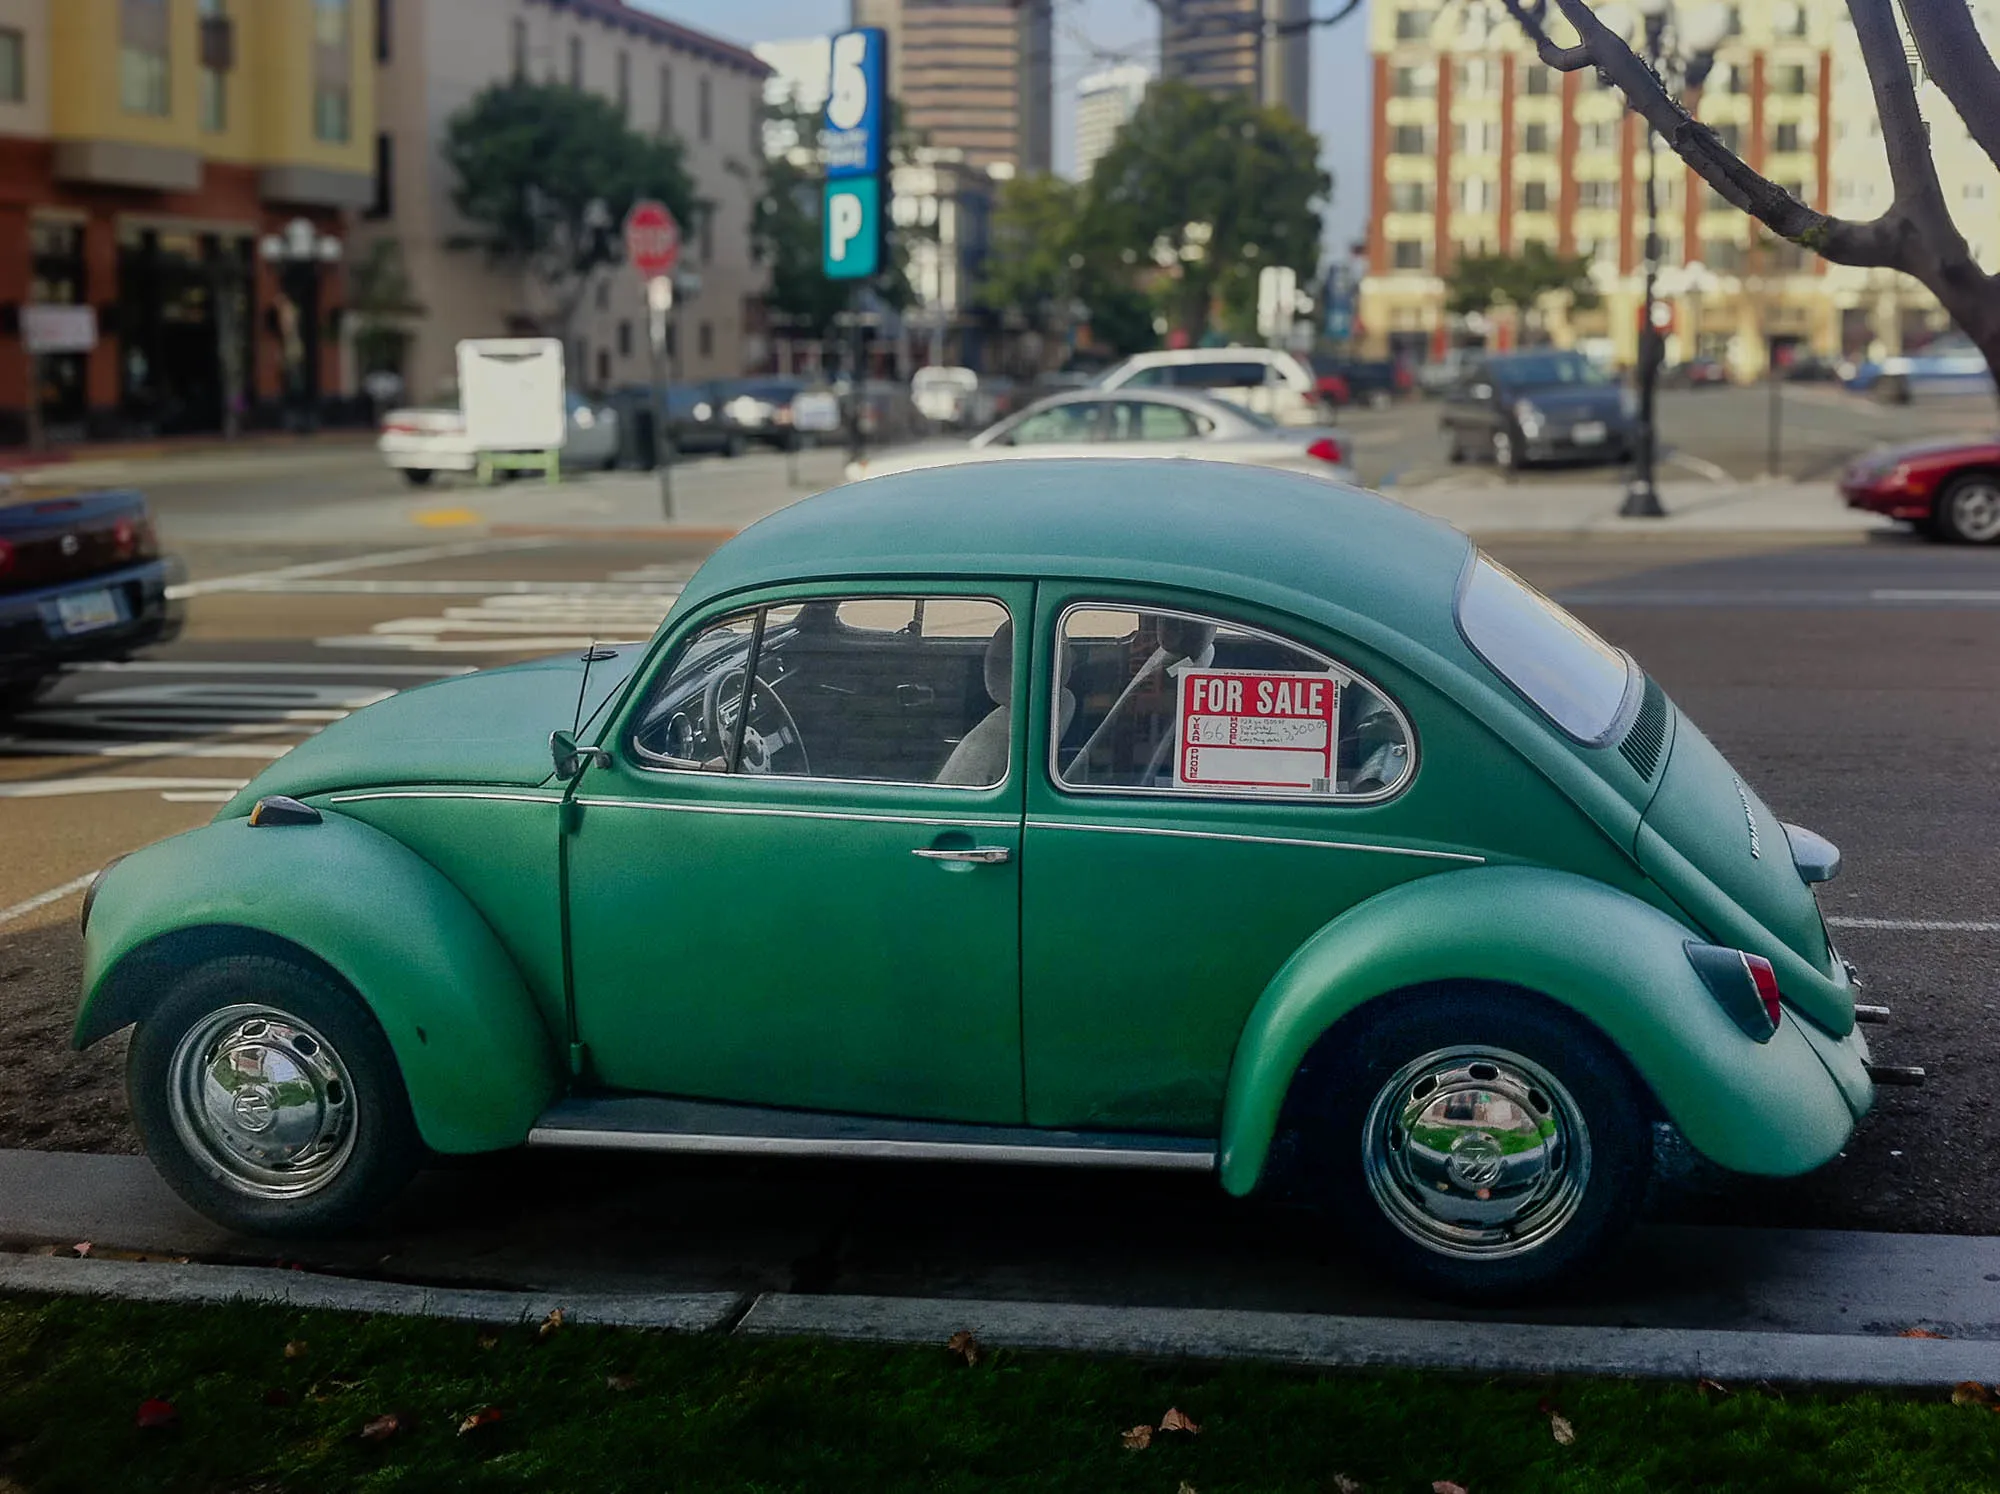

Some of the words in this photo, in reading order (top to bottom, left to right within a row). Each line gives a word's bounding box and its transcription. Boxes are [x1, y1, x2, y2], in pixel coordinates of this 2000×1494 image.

[827, 31, 867, 129] 5
[829, 193, 862, 261] P
[1193, 679, 1243, 713] FOR
[1256, 680, 1324, 716] SALE
[1191, 717, 1200, 742] YEAR
[1203, 721, 1224, 740] 66
[1229, 717, 1238, 744] MODEL
[1190, 748, 1200, 779] PHONE
